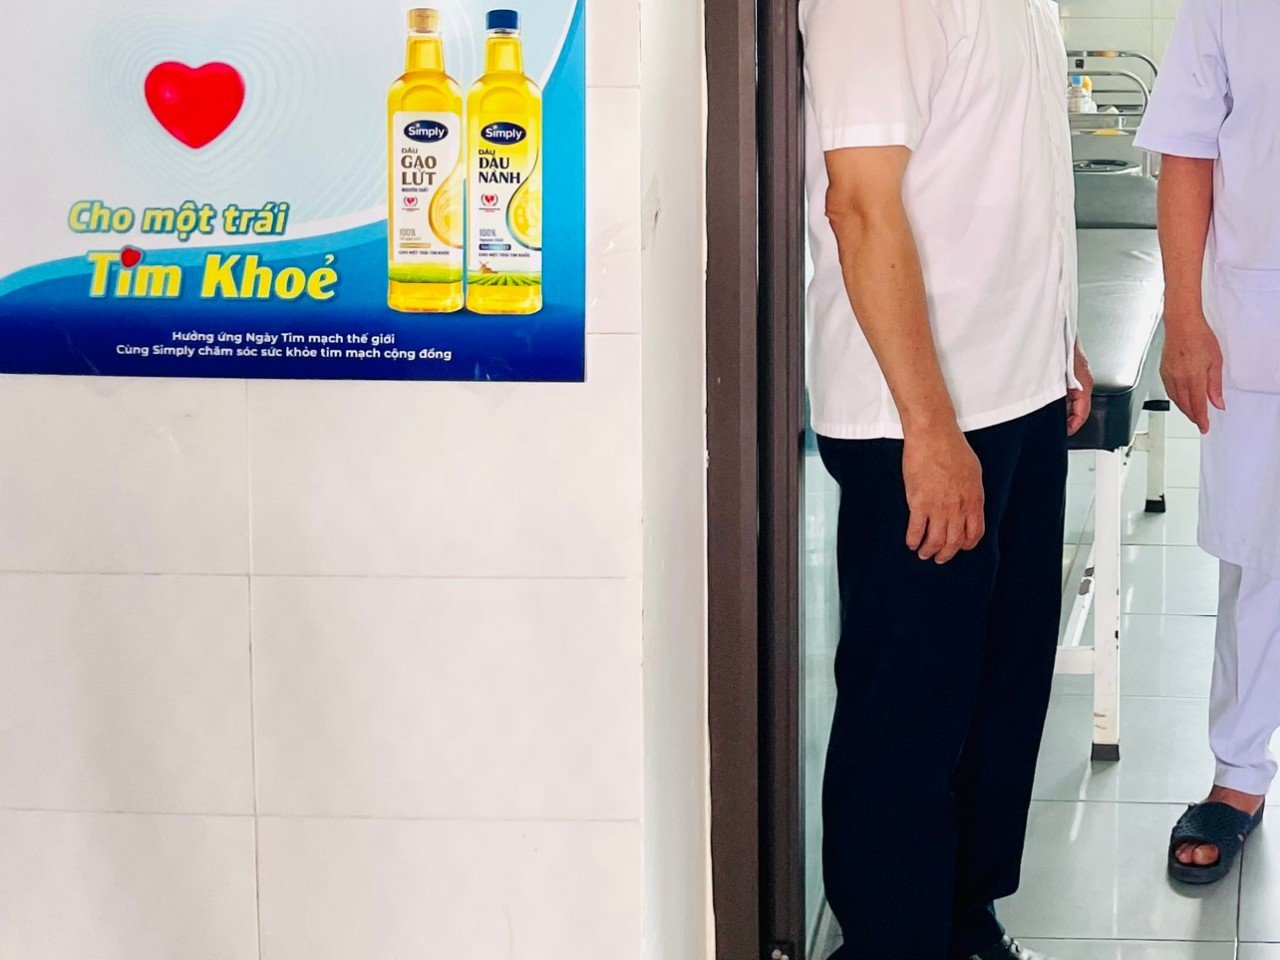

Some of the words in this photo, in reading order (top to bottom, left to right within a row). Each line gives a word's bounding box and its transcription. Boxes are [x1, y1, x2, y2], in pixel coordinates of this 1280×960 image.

[408, 123, 445, 139] Simply
[485, 125, 522, 140] Simply
[68, 200, 134, 233] Cho
[141, 200, 217, 242] một
[223, 201, 290, 235] trái
[87, 246, 182, 298] Tim
[217, 332, 242, 344] ứng
[246, 332, 278, 344] Ngày
[281, 332, 306, 342] Tim
[308, 333, 343, 345] mạch
[346, 332, 368, 343] thế
[371, 333, 394, 345] giới
[116, 344, 148, 356] Cùng
[152, 344, 195, 357] Simply
[198, 345, 232, 355] chăm
[236, 346, 257, 356] sóc
[260, 346, 282, 356] sức
[320, 347, 342, 357] tim
[346, 347, 380, 359] mạch
[384, 348, 415, 360] cộng
[418, 348, 451, 360] đồng
